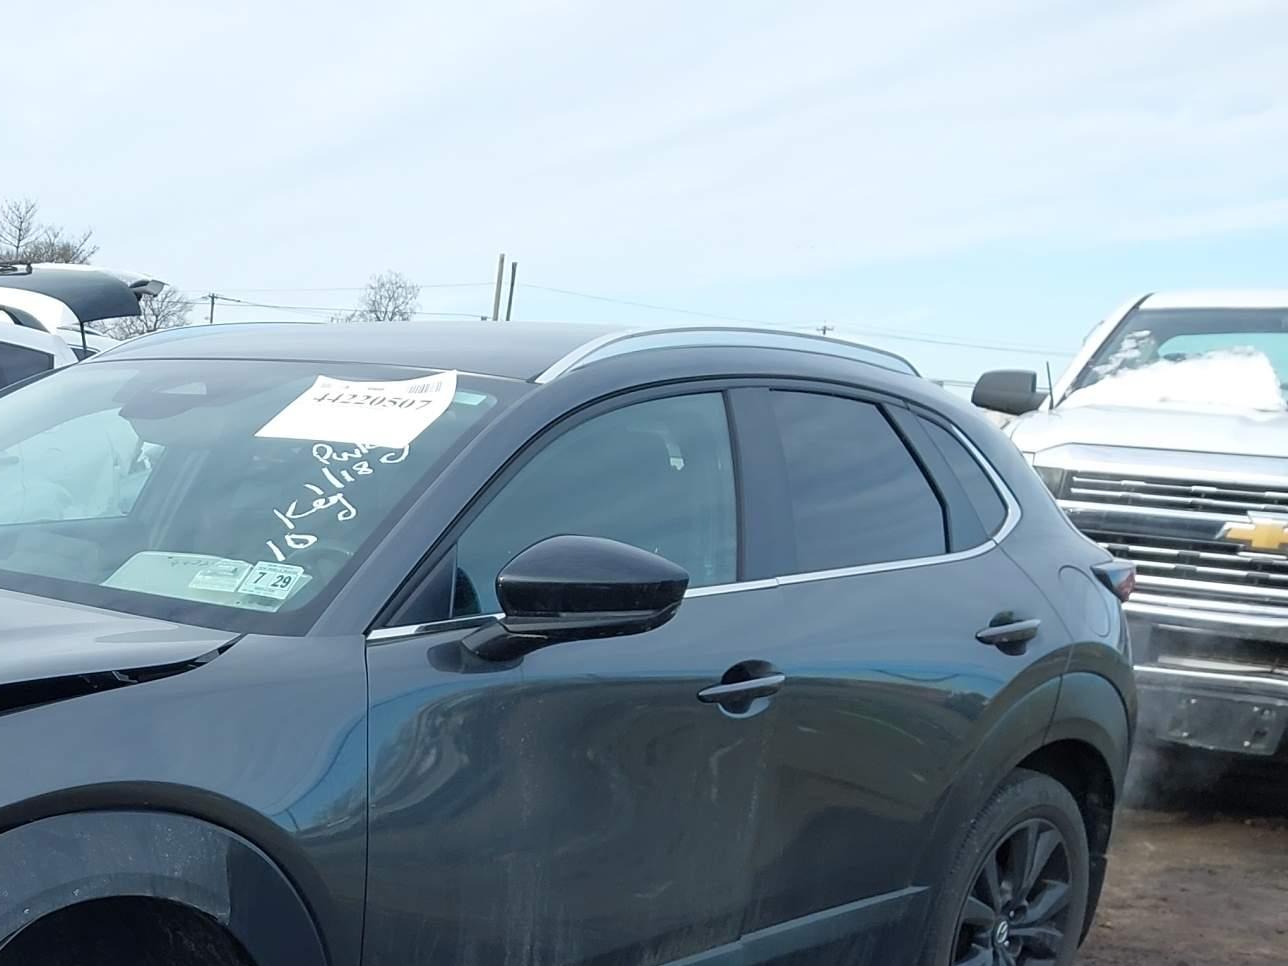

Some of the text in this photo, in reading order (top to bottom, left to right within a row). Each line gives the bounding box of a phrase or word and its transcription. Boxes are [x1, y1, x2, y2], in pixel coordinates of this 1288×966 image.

[313, 392, 433, 410] 44220507
[253, 571, 292, 589] 7 29
